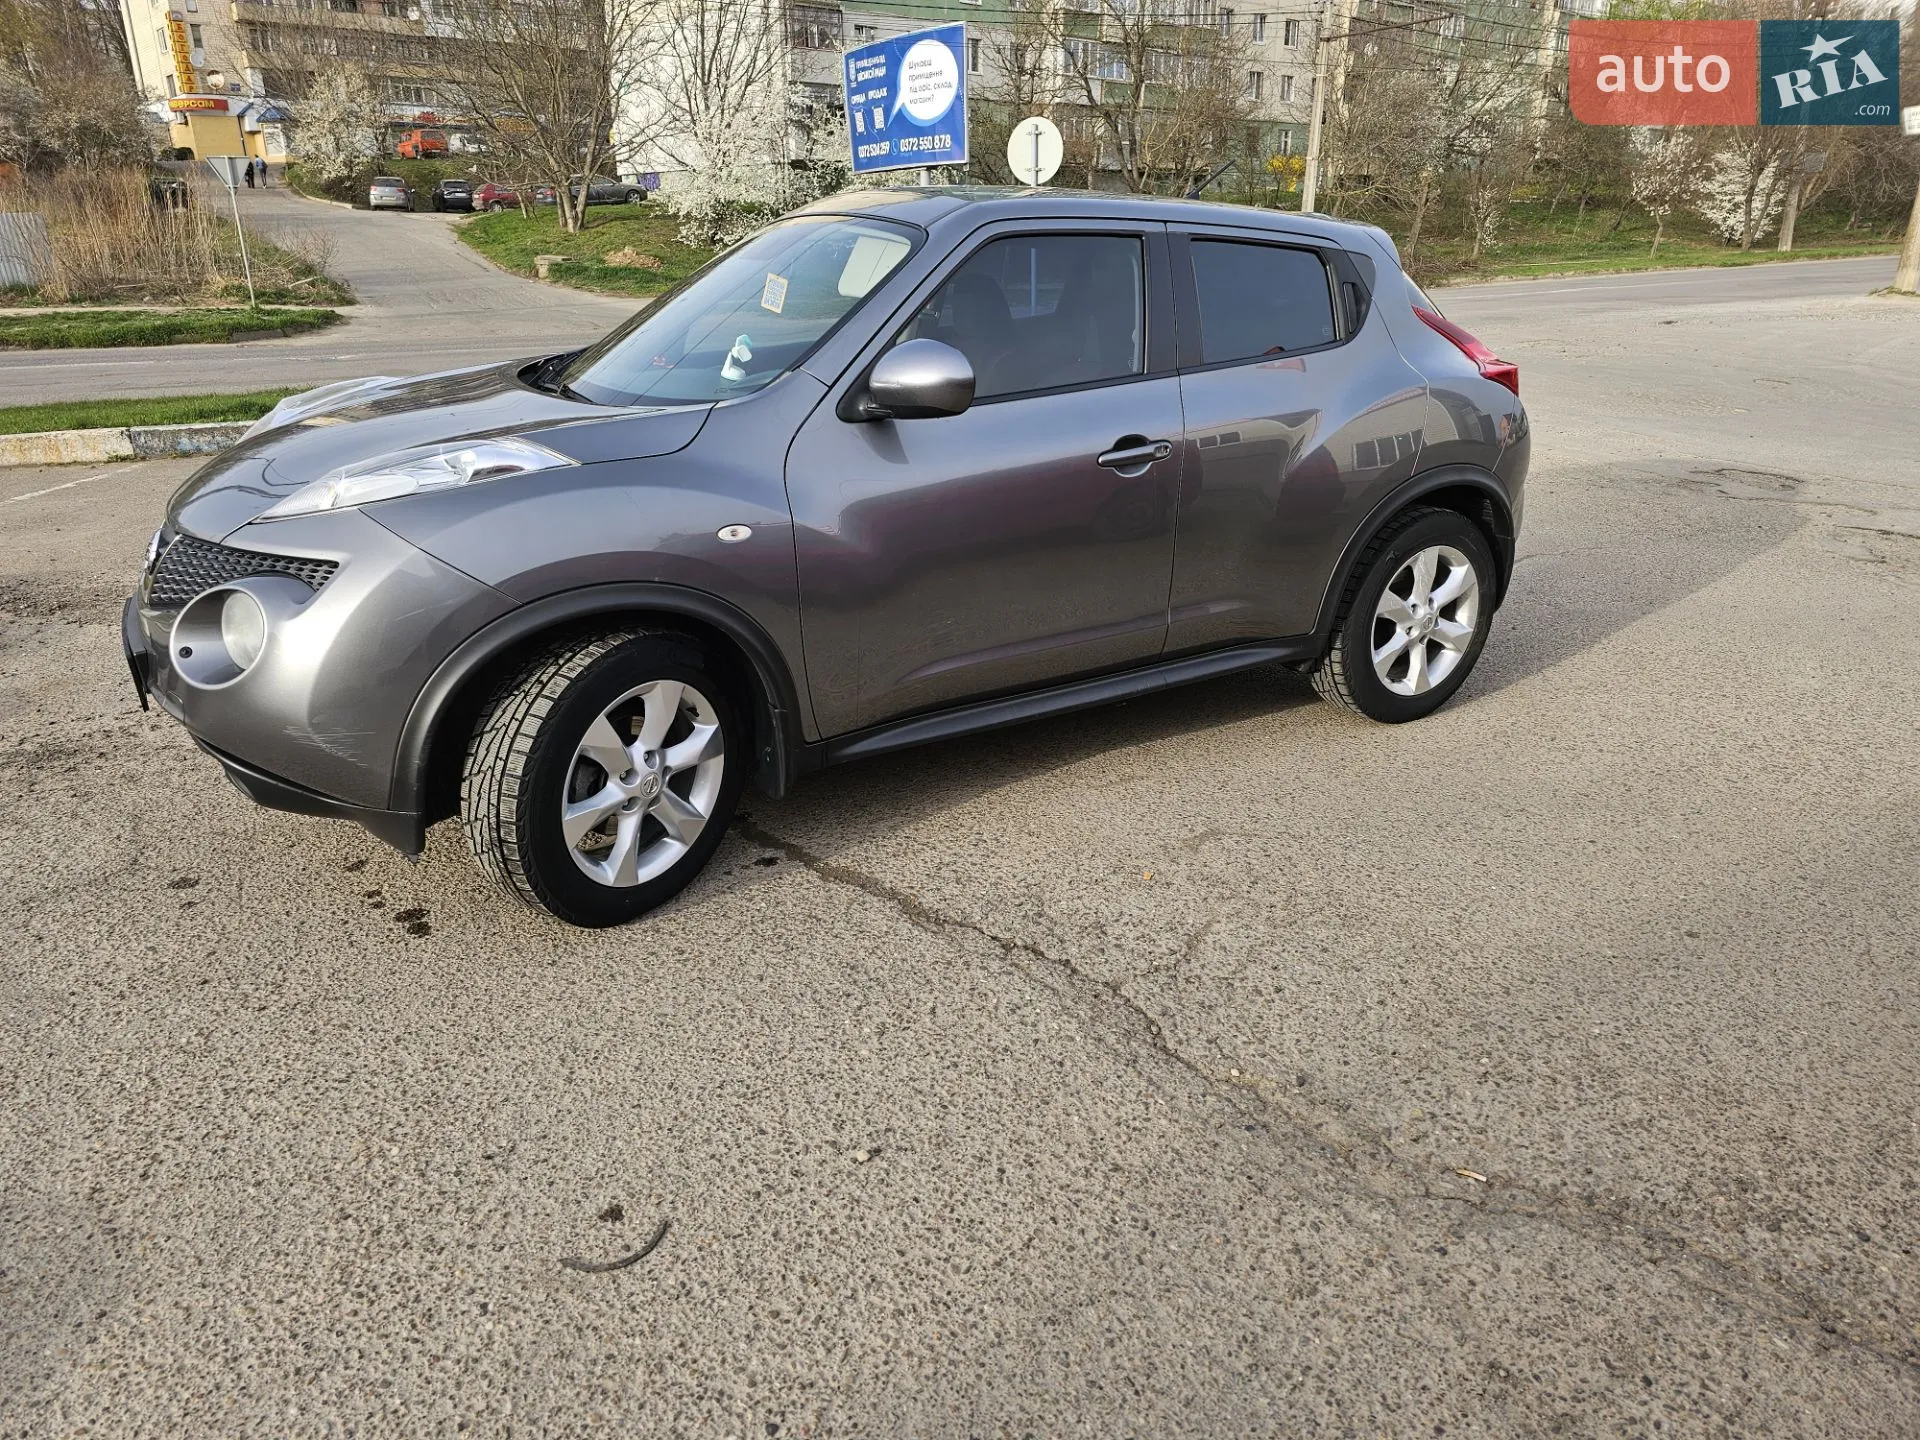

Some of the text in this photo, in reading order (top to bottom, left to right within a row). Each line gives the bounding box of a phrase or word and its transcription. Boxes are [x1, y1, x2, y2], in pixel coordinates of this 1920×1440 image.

[908, 70, 943, 82] приміщення
[868, 87, 888, 100] ПРОДАЖ
[900, 134, 952, 152] 0372 550 878
